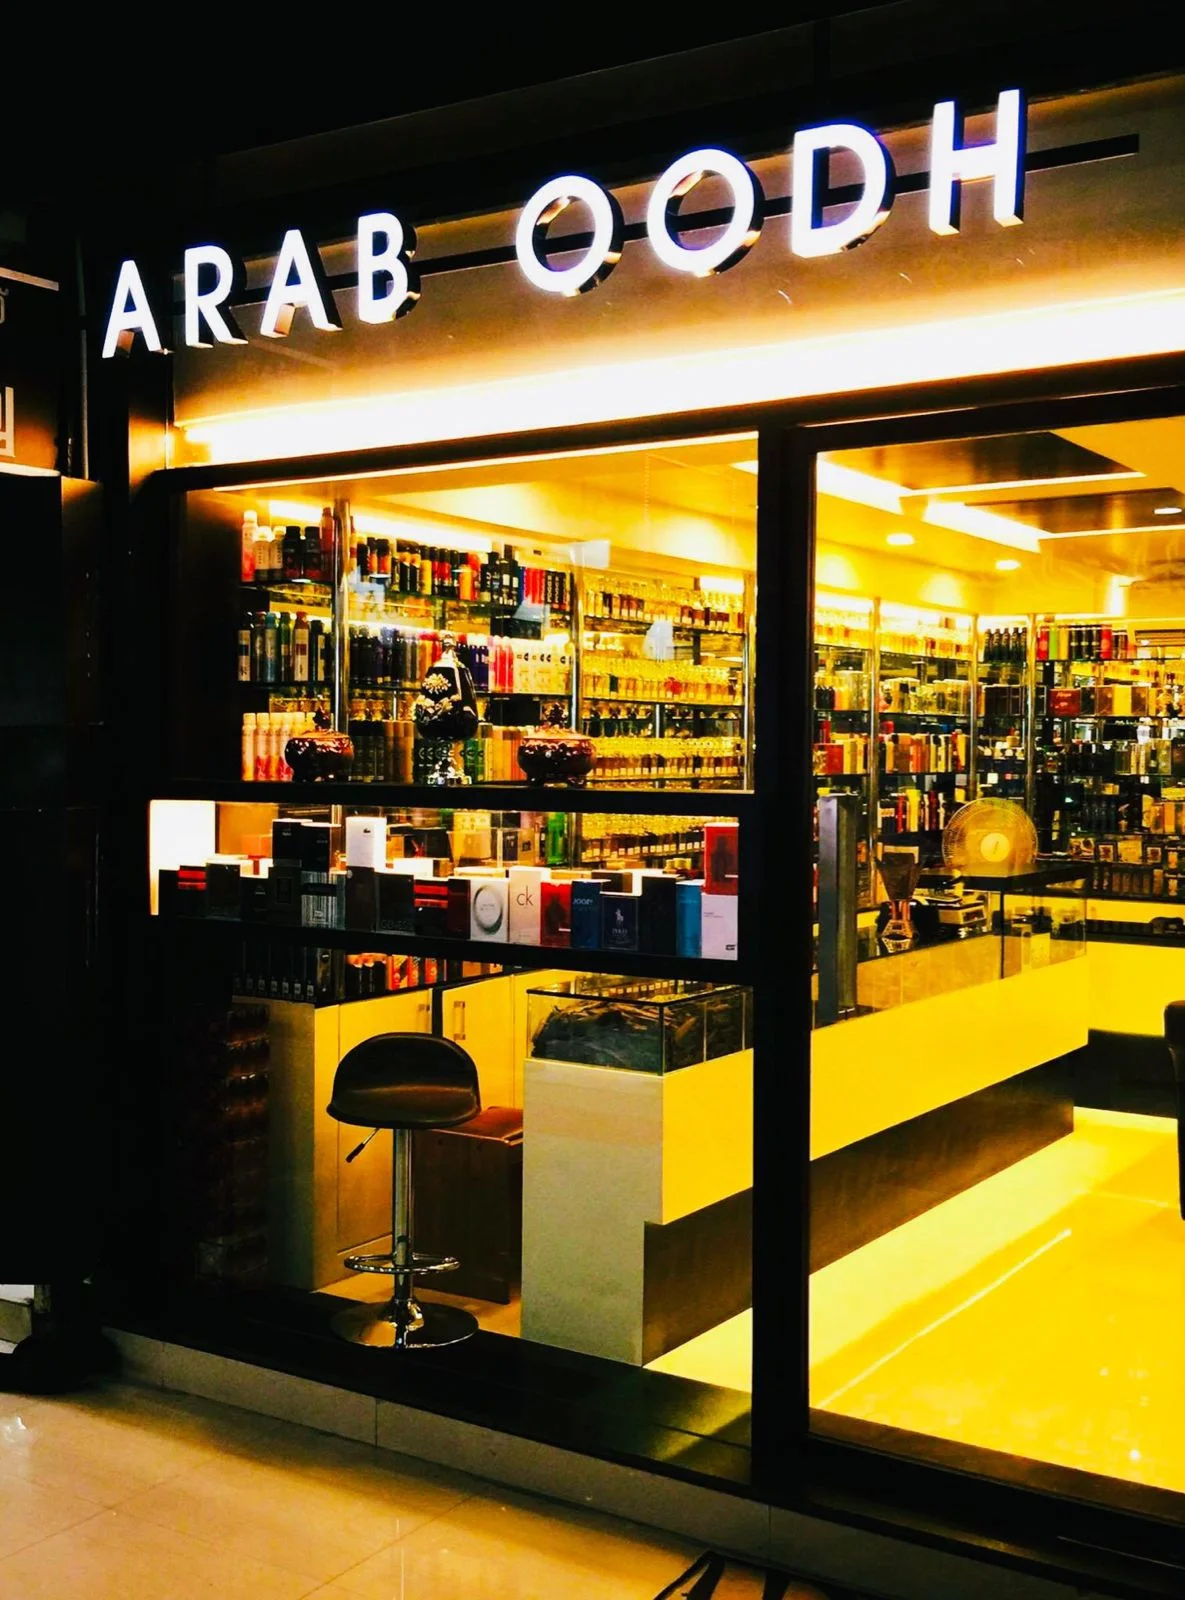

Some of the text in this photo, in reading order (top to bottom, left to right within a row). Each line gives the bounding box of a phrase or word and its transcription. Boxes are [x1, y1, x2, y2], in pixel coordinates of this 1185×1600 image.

[102, 88, 1024, 358] ARAB OODH
[516, 884, 534, 906] ck
